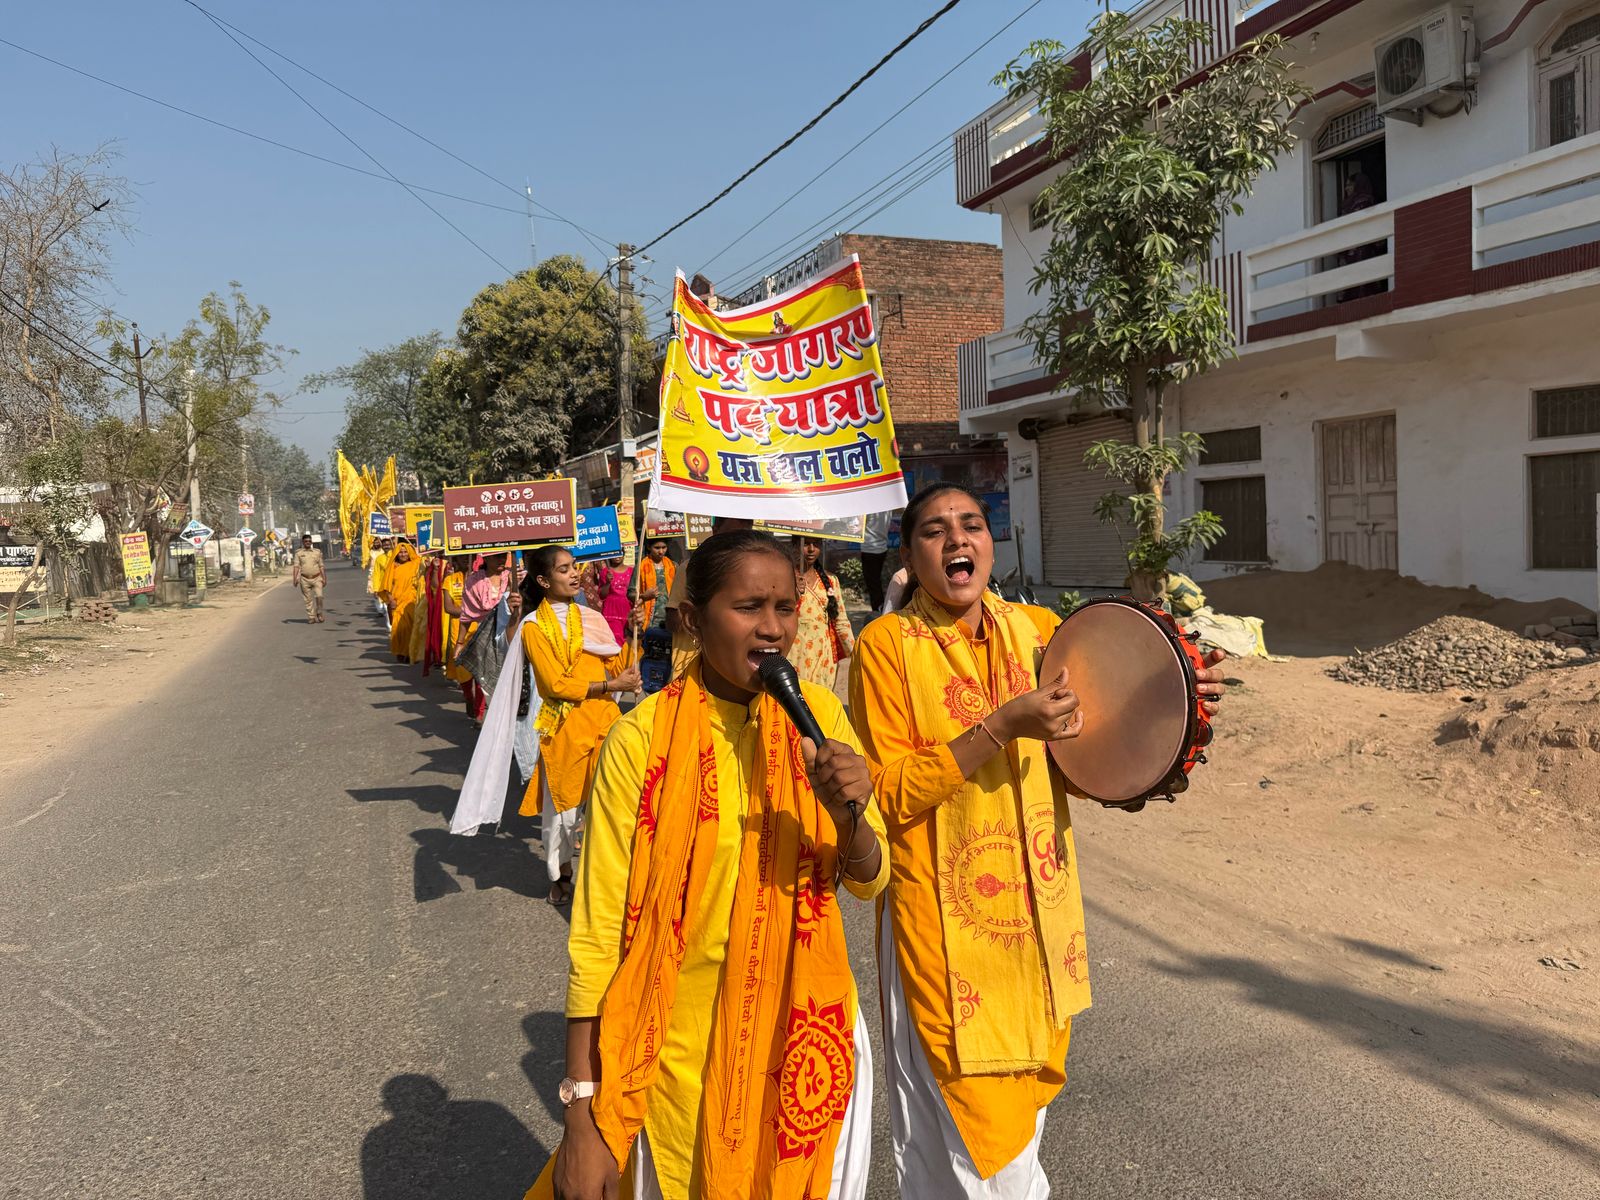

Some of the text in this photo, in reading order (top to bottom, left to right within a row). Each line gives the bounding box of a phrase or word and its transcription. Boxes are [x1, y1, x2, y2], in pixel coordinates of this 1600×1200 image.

[768, 372, 884, 435] यात्रा
[825, 432, 882, 477] चलो
[504, 502, 529, 513] शराब,
[453, 521, 470, 532] तन,
[472, 520, 489, 531] मन,
[490, 519, 504, 528] धन
[505, 515, 515, 527] के
[517, 515, 525, 526] ये
[526, 516, 541, 526] सब
